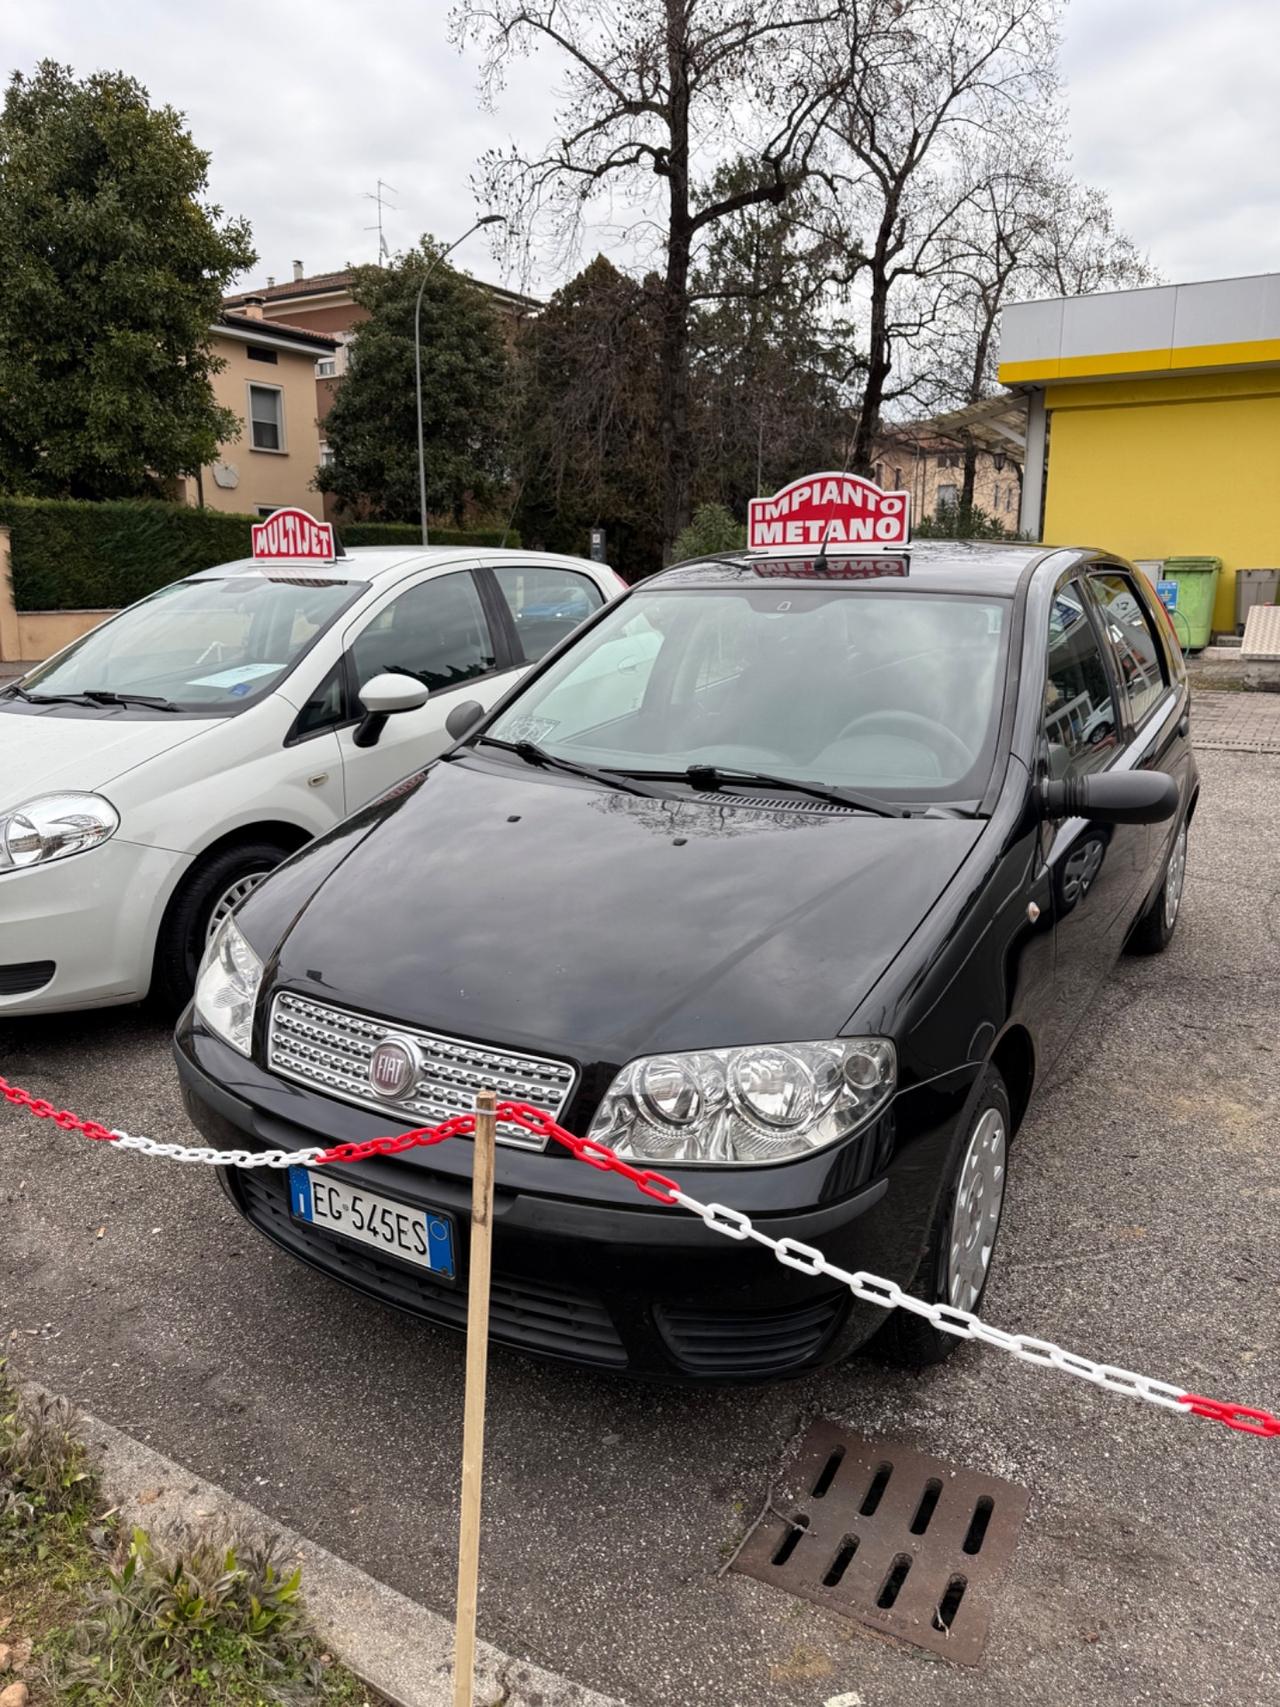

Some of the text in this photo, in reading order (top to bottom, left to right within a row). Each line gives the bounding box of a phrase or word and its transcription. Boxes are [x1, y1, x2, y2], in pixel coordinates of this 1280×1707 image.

[754, 480, 903, 521] IMPIANTO
[255, 515, 330, 555] MULTIJET
[754, 516, 900, 544] METANO
[376, 1054, 404, 1084] FIAT
[312, 1181, 428, 1256] EG 545ES
